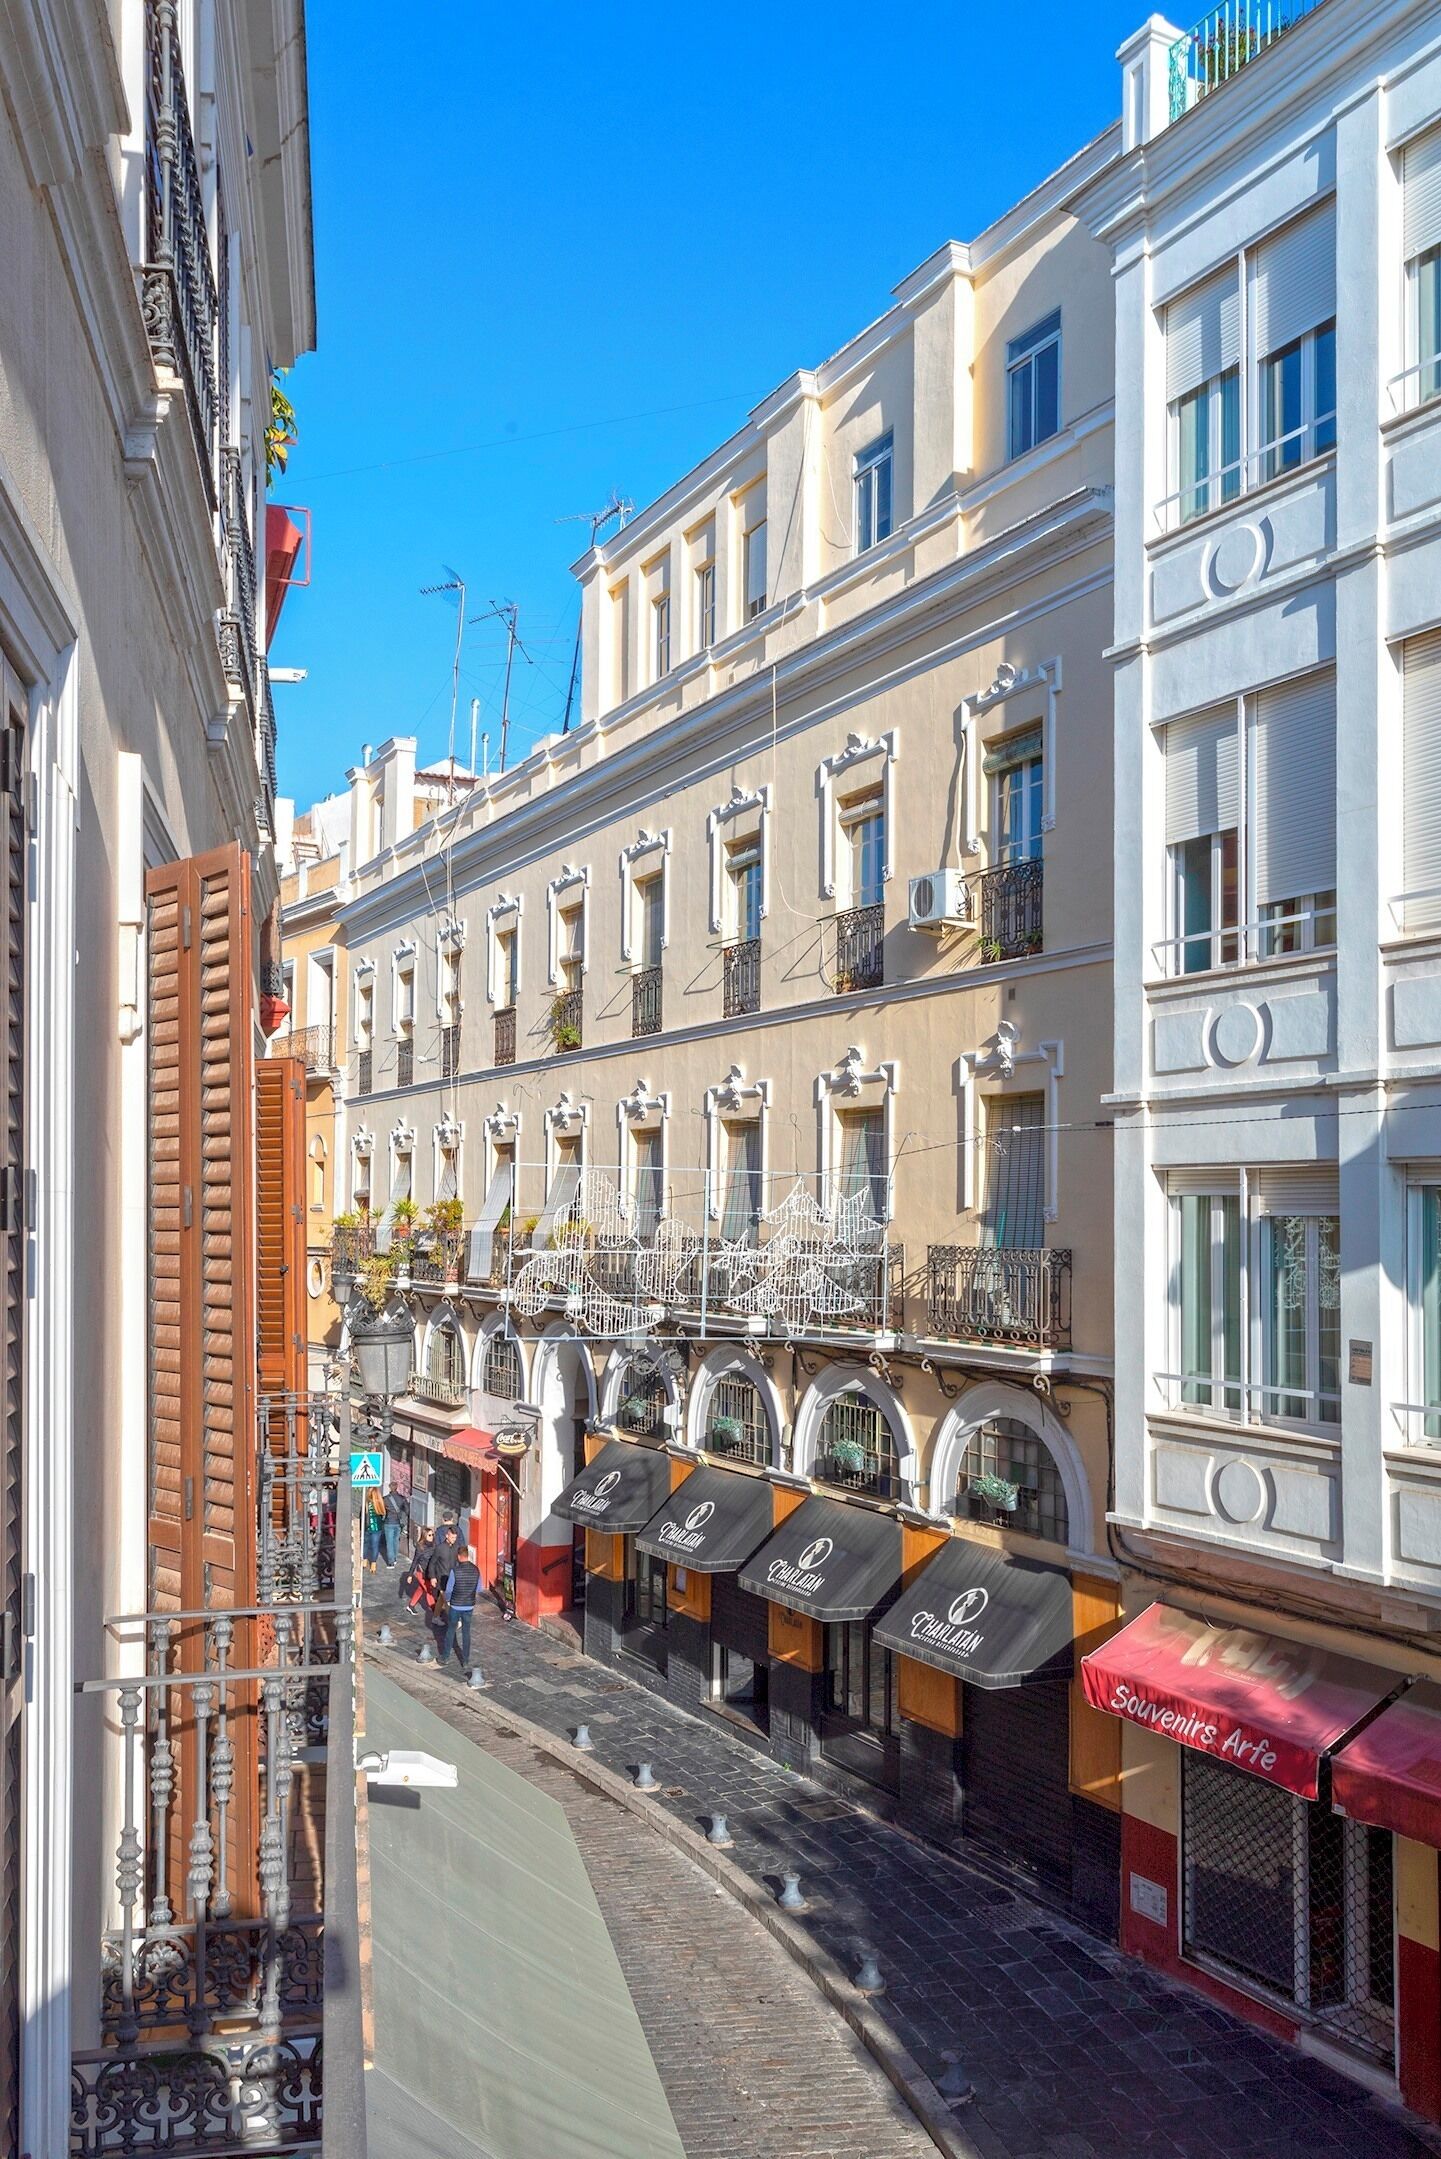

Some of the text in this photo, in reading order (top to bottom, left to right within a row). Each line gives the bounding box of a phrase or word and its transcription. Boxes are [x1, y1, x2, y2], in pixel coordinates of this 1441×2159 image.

[767, 1559, 825, 1592] CHARLATÁN
[911, 1611, 984, 1652] CHARLATÁN
[1111, 1685, 1277, 1772] Souvenirs Arfe
